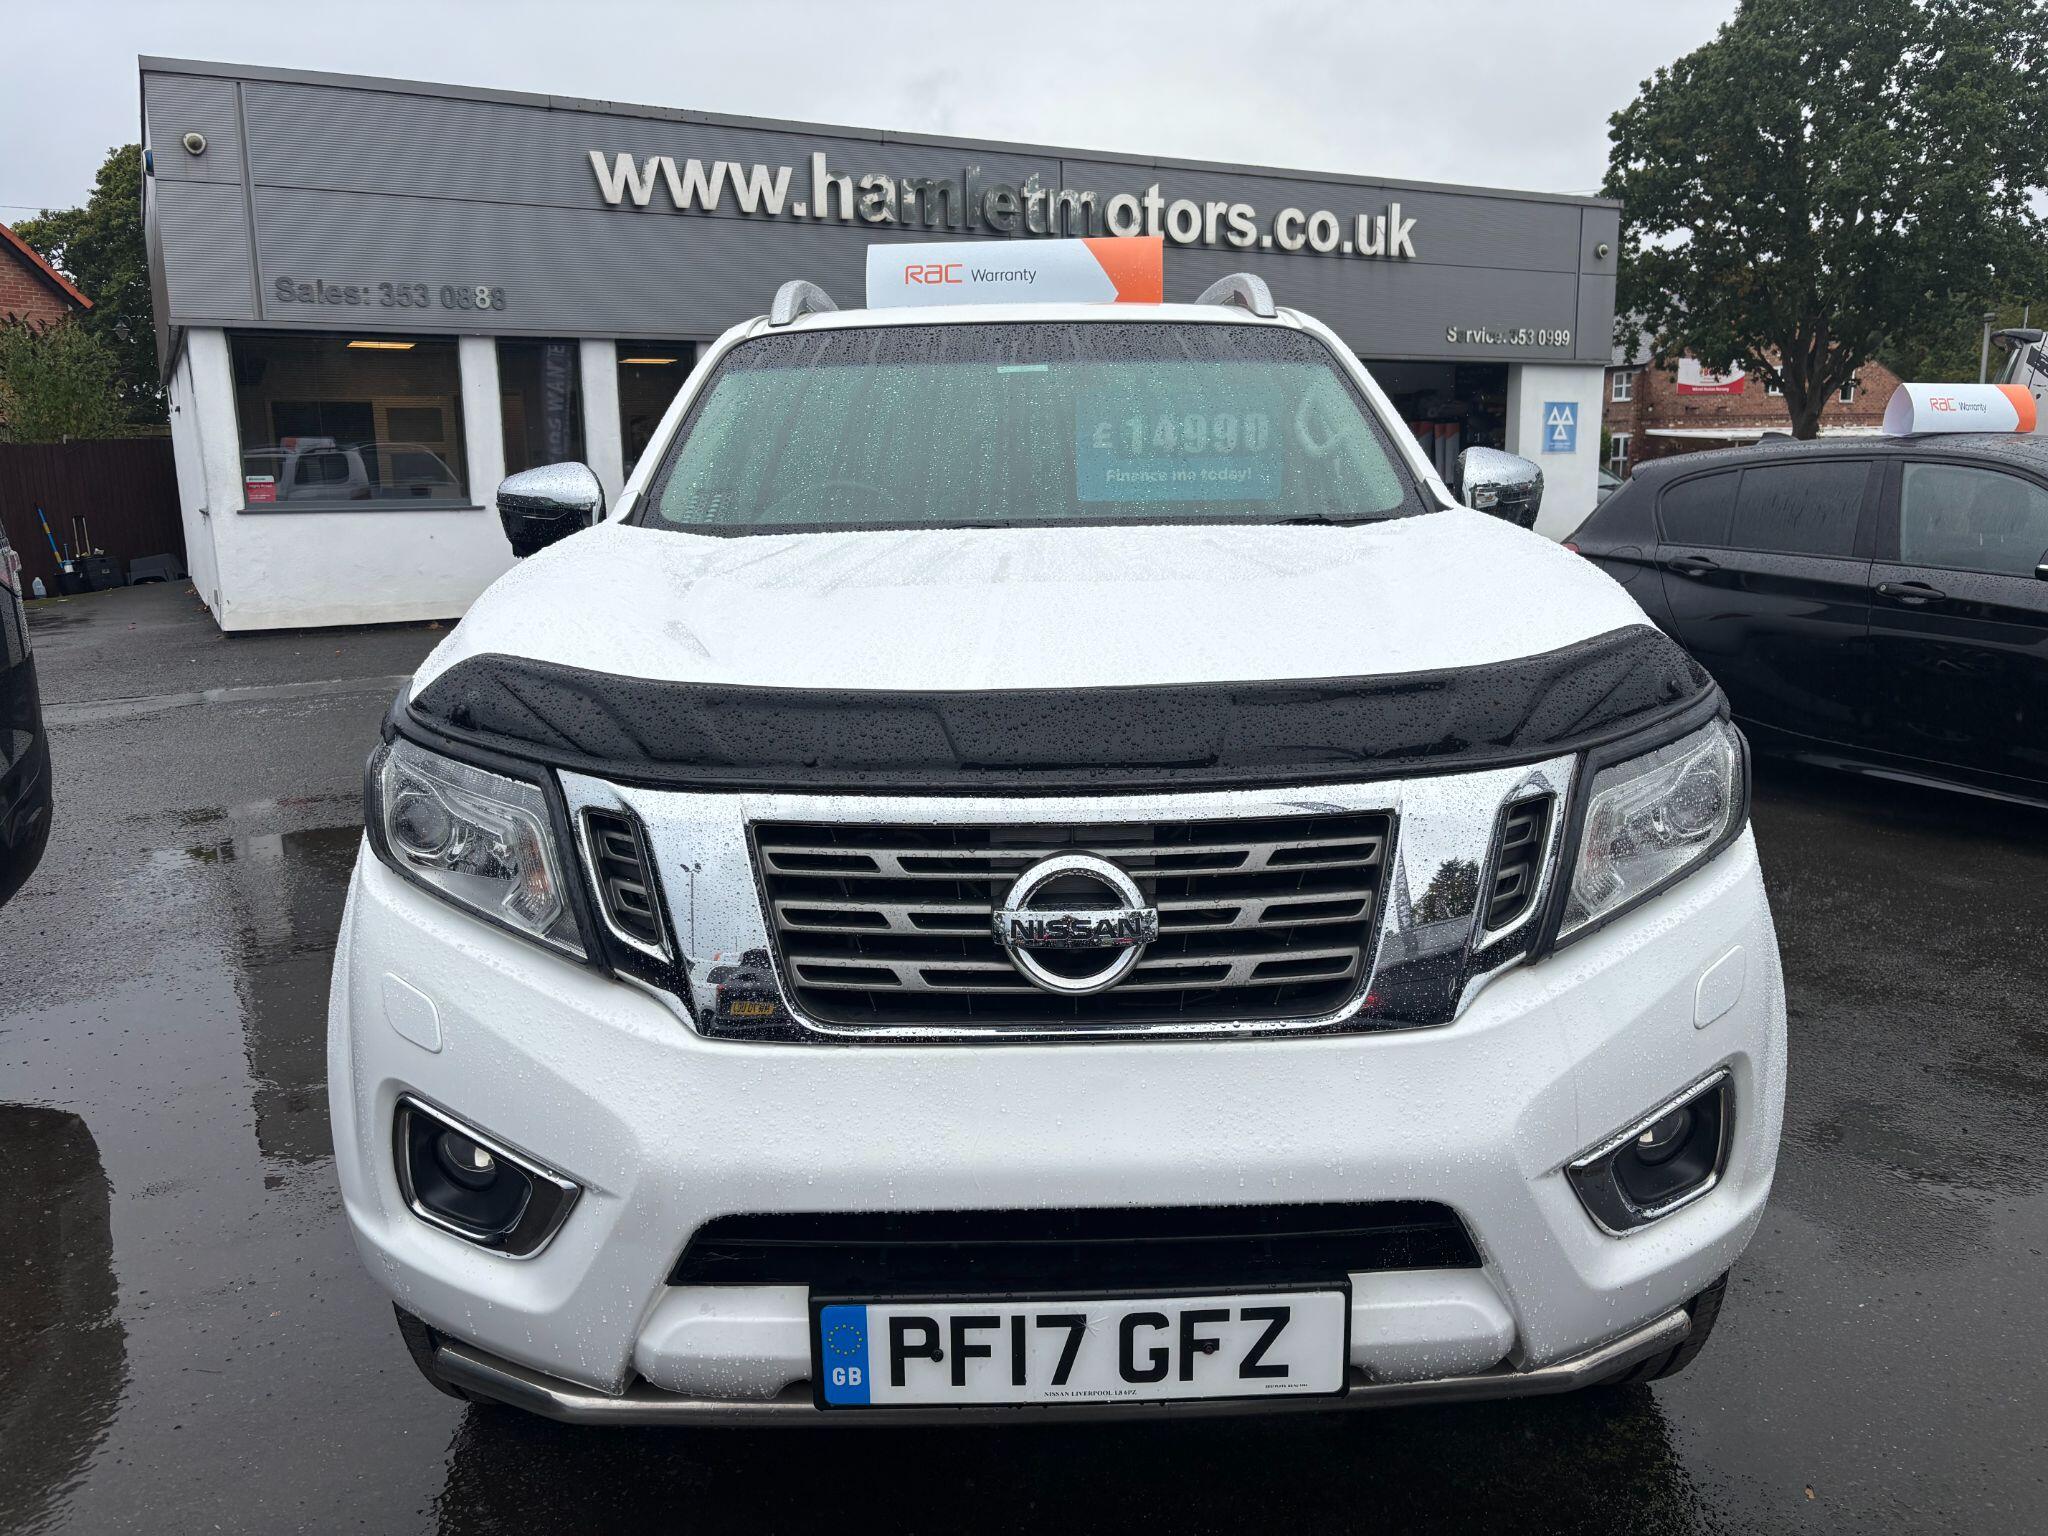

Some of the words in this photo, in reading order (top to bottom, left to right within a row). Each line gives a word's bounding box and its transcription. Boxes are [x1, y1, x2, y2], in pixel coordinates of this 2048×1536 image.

[970, 267, 1037, 285] Warranty
[274, 275, 371, 305] Sales:
[378, 281, 431, 307] 353
[440, 284, 506, 311] 0888
[1537, 328, 1571, 347] 0999
[1958, 401, 1987, 414] Warranty
[1201, 467, 1252, 482] today!
[1010, 917, 1142, 939] NISSAN
[888, 1313, 1088, 1387] PF17
[1118, 1306, 1291, 1384] GFZ
[832, 1367, 862, 1386] GB
